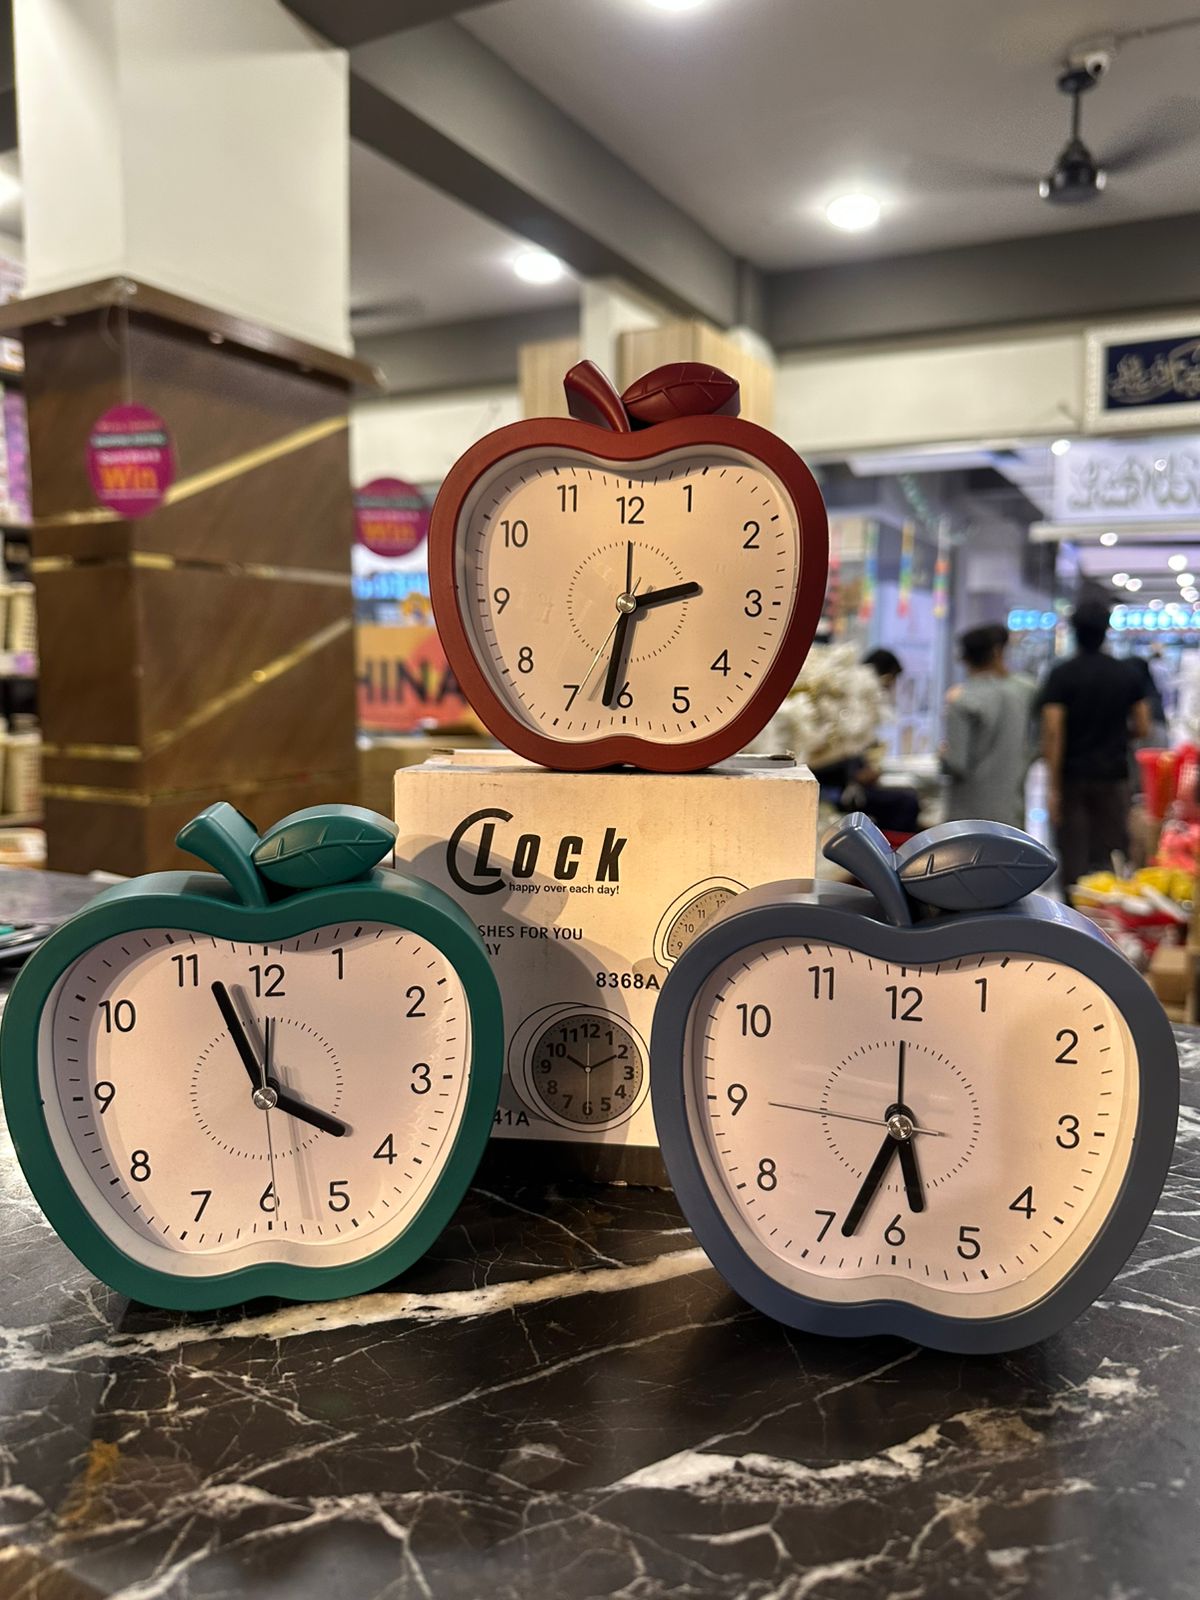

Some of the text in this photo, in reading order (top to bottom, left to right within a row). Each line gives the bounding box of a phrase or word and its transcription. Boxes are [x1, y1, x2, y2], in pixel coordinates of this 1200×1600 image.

[557, 485, 578, 512] 11
[616, 496, 645, 525] 12
[683, 484, 692, 512] 1
[500, 520, 529, 548] 10
[742, 521, 760, 549] 2
[493, 587, 510, 615] 9
[743, 589, 763, 617] 3
[517, 646, 534, 674] 8
[710, 649, 731, 676] 4
[562, 684, 580, 711] 7
[617, 681, 634, 708] 6
[672, 686, 690, 714] 5
[509, 882, 619, 896] happy over each day!
[698, 909, 706, 918] 11
[520, 927, 548, 939] FOR
[553, 928, 583, 940] YOU
[684, 924, 694, 933] 10
[677, 941, 683, 950] 9
[171, 954, 200, 987] 11
[331, 948, 344, 980] 1
[248, 964, 286, 998] 12
[596, 972, 660, 989] 8368A
[808, 965, 834, 1000] 11
[406, 986, 426, 1018] 2
[885, 986, 923, 1022] 12
[974, 978, 987, 1012] 1
[99, 1000, 136, 1033] 10
[736, 1003, 771, 1038] 10
[559, 1028, 578, 1043] 11
[580, 1023, 600, 1039] 12
[605, 1031, 613, 1046] 1
[546, 1043, 567, 1058] 10
[617, 1044, 628, 1060] 2
[1055, 1029, 1078, 1064] 2
[411, 1062, 431, 1094] 3
[540, 1059, 552, 1074] 9
[623, 1066, 635, 1080] 3
[94, 1081, 116, 1114] 9
[547, 1080, 558, 1095] 8
[562, 1094, 574, 1109] 7
[614, 1084, 627, 1099] 4
[727, 1083, 748, 1116] 9
[582, 1101, 593, 1116] 6
[600, 1097, 611, 1112] 5
[1056, 1114, 1079, 1149] 3
[373, 1133, 397, 1164] 4
[130, 1150, 151, 1182] 8
[757, 1158, 778, 1192] 8
[190, 1190, 212, 1222] 7
[259, 1181, 281, 1213] 6
[328, 1180, 350, 1212] 5
[1009, 1186, 1036, 1220] 4
[814, 1209, 836, 1242] 7
[884, 1214, 906, 1247] 6
[957, 1226, 981, 1260] 5
